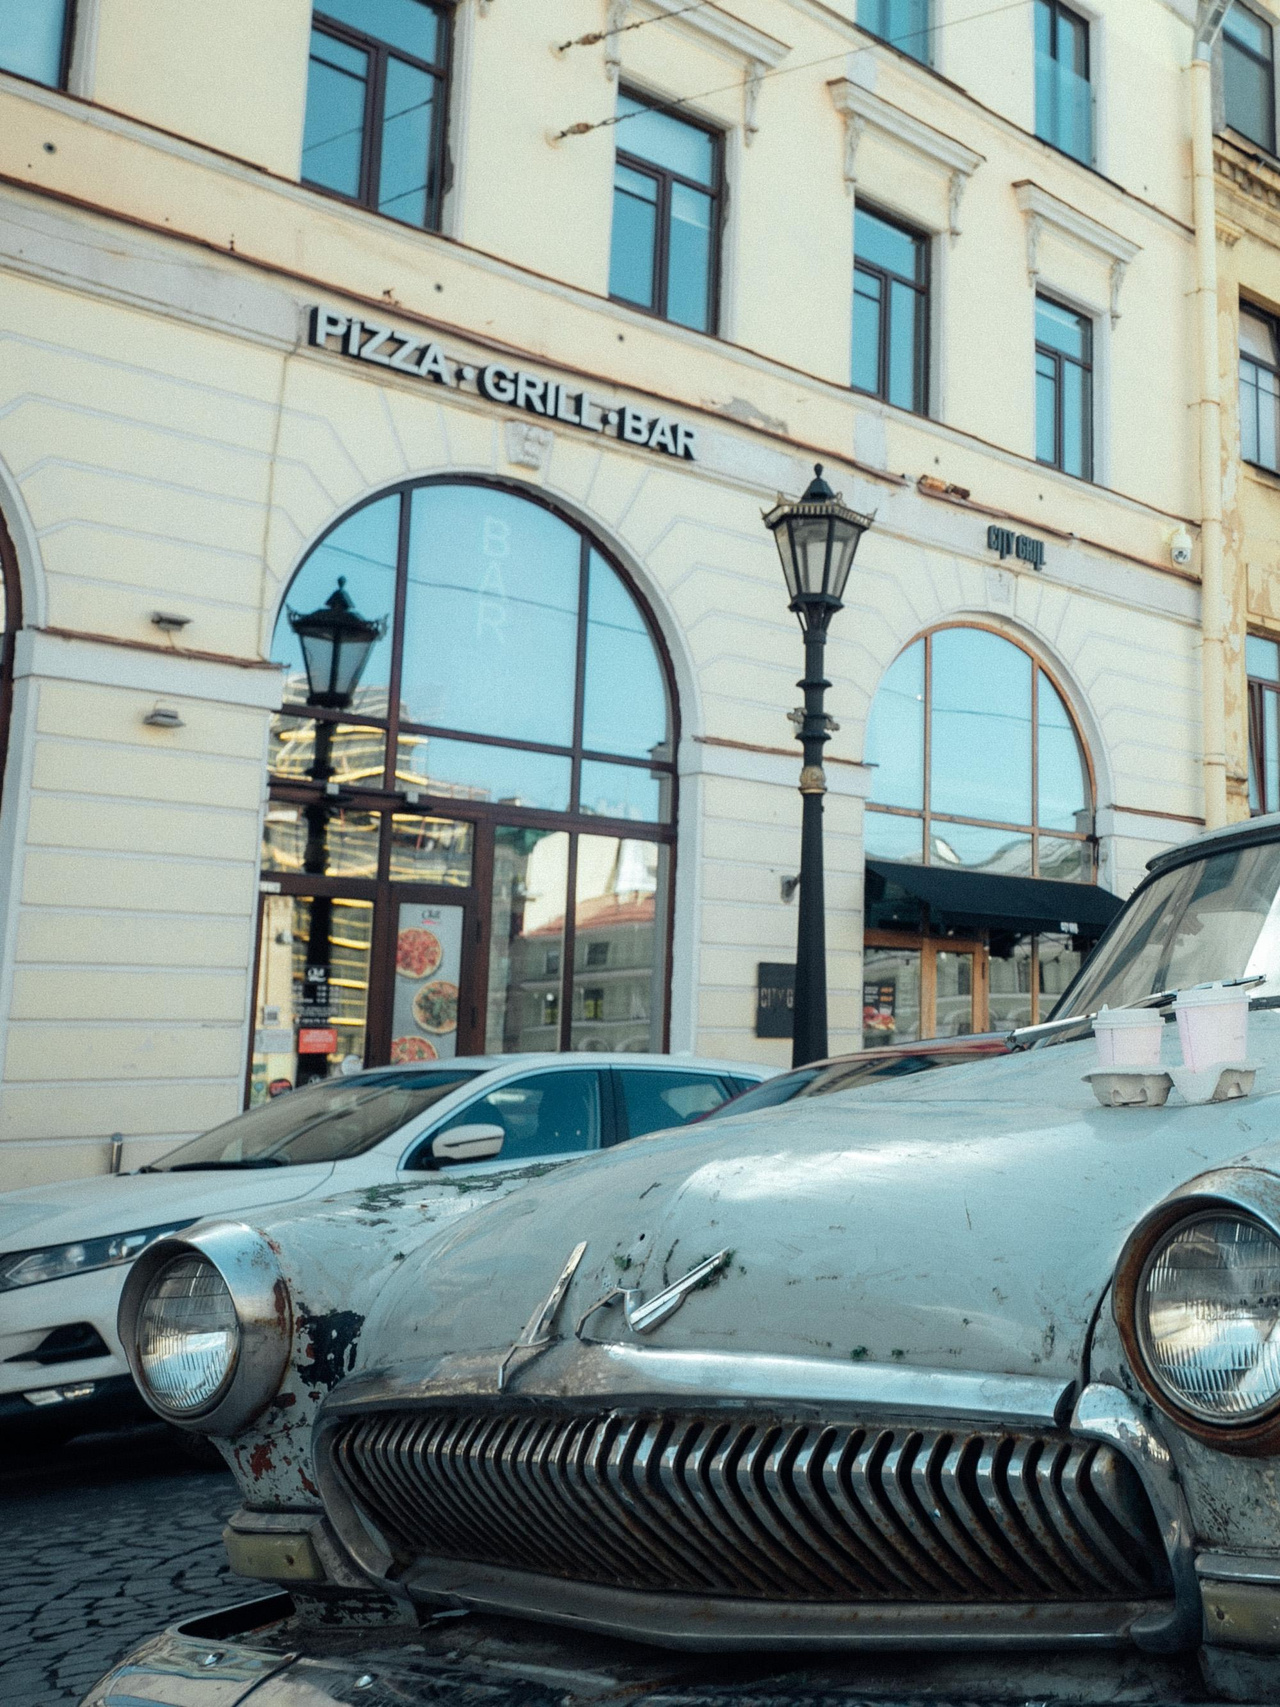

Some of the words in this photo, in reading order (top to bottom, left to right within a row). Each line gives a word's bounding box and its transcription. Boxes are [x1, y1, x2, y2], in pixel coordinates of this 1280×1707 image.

[311, 306, 451, 386] PIZZA
[480, 363, 605, 431] GRILL
[619, 406, 697, 460] BAR
[476, 515, 512, 644] BAR
[988, 525, 1015, 560] CITY
[760, 987, 786, 1008] CITY
